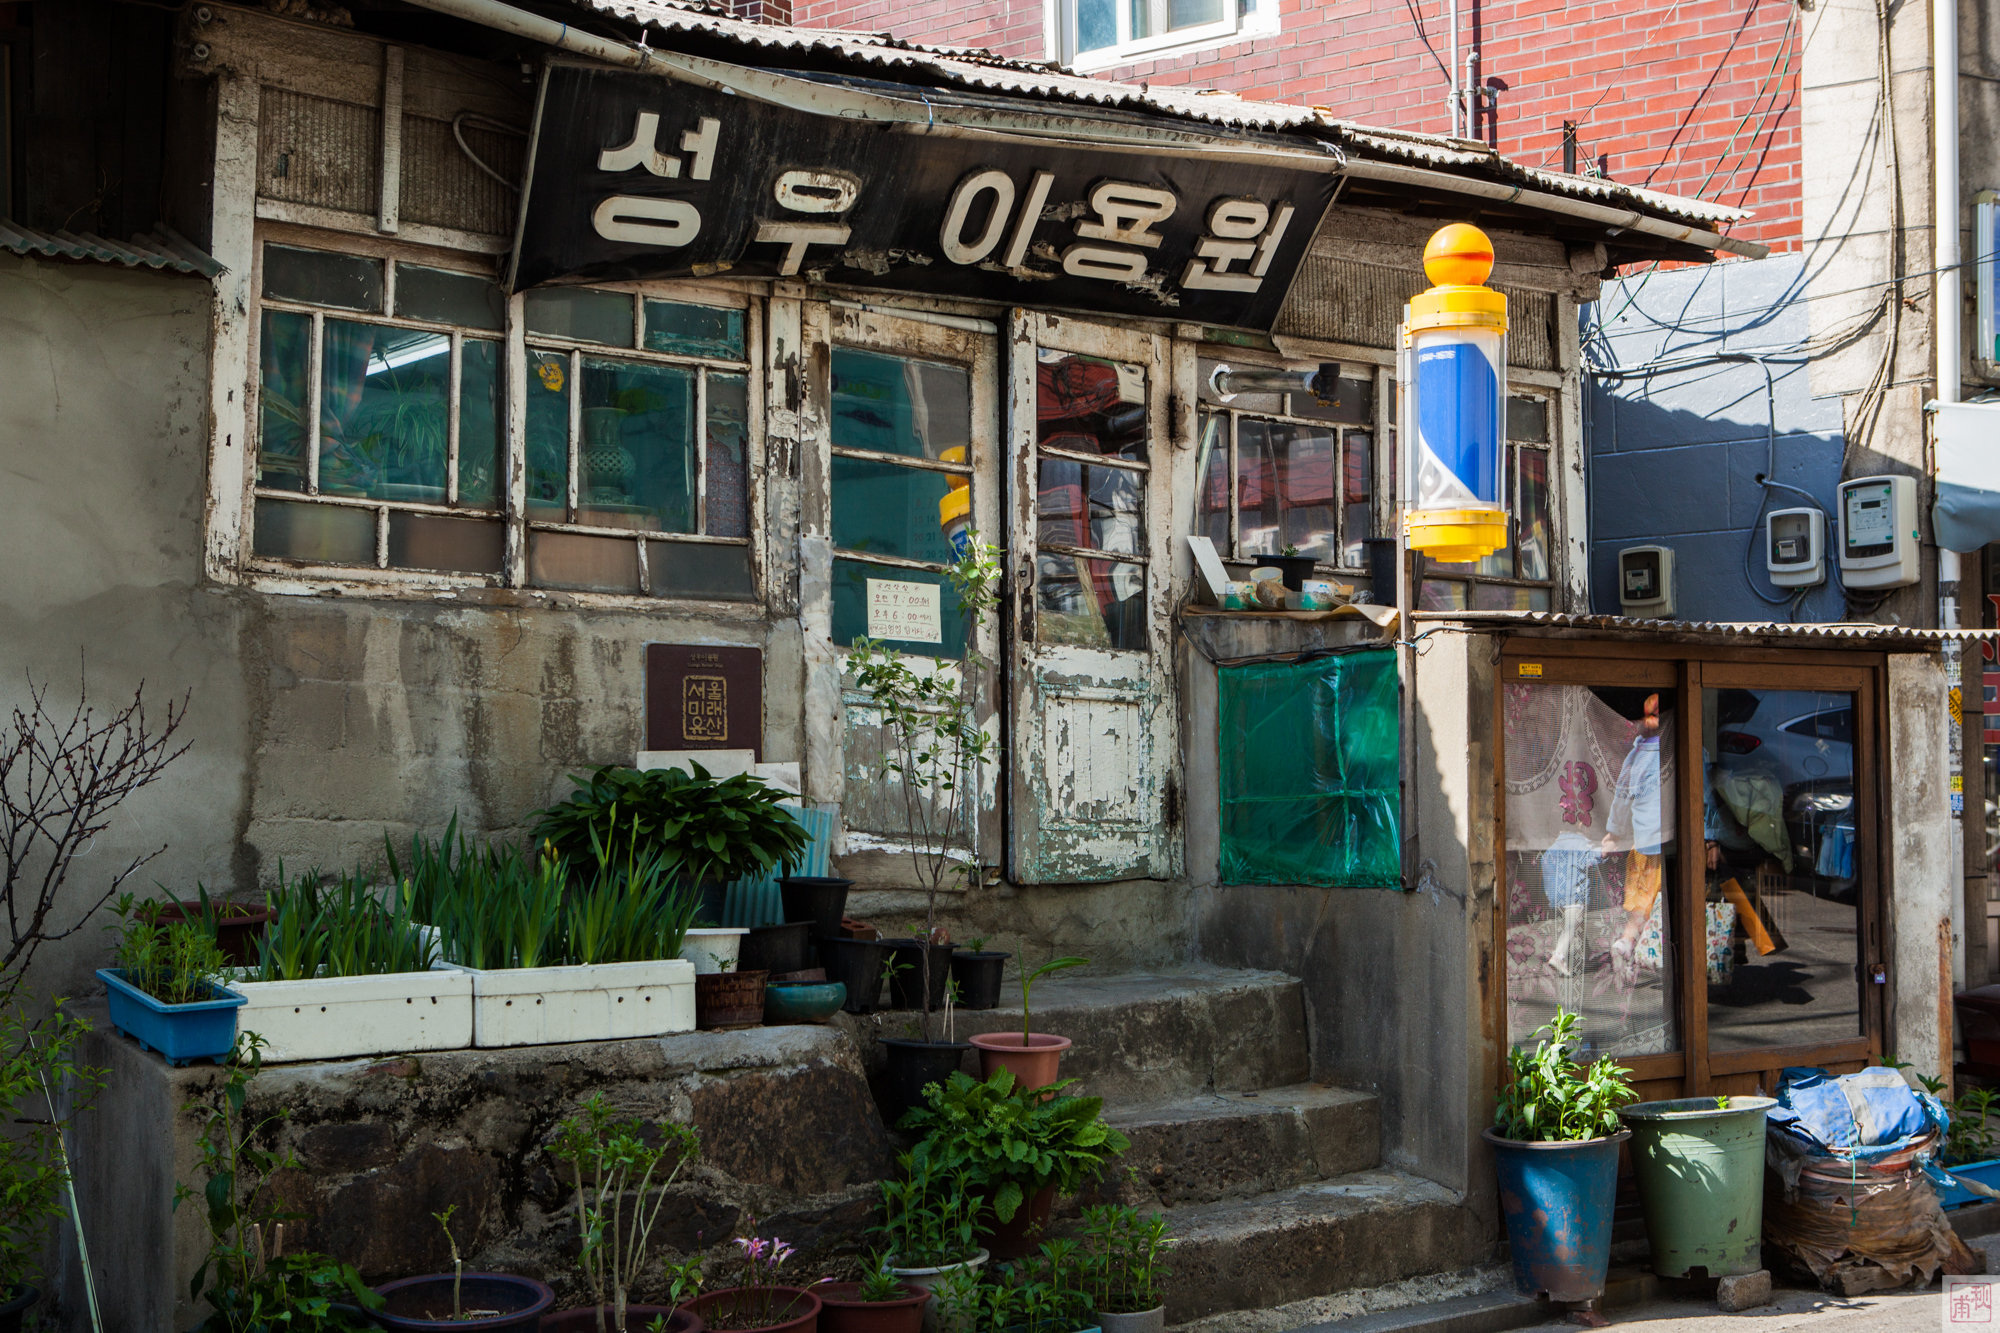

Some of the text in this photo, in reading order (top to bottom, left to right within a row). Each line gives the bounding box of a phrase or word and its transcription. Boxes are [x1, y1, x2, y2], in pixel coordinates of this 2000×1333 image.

[916, 496, 934, 509] 6 7
[913, 514, 936, 526] 13 14
[913, 533, 924, 543] 20
[926, 532, 936, 542] 21
[913, 549, 949, 560] 27 28 29
[874, 593, 889, 604] 오전
[873, 608, 889, 620] 오후
[688, 681, 722, 700] 서울
[688, 701, 722, 716] 미래
[688, 716, 723, 736] 유산
